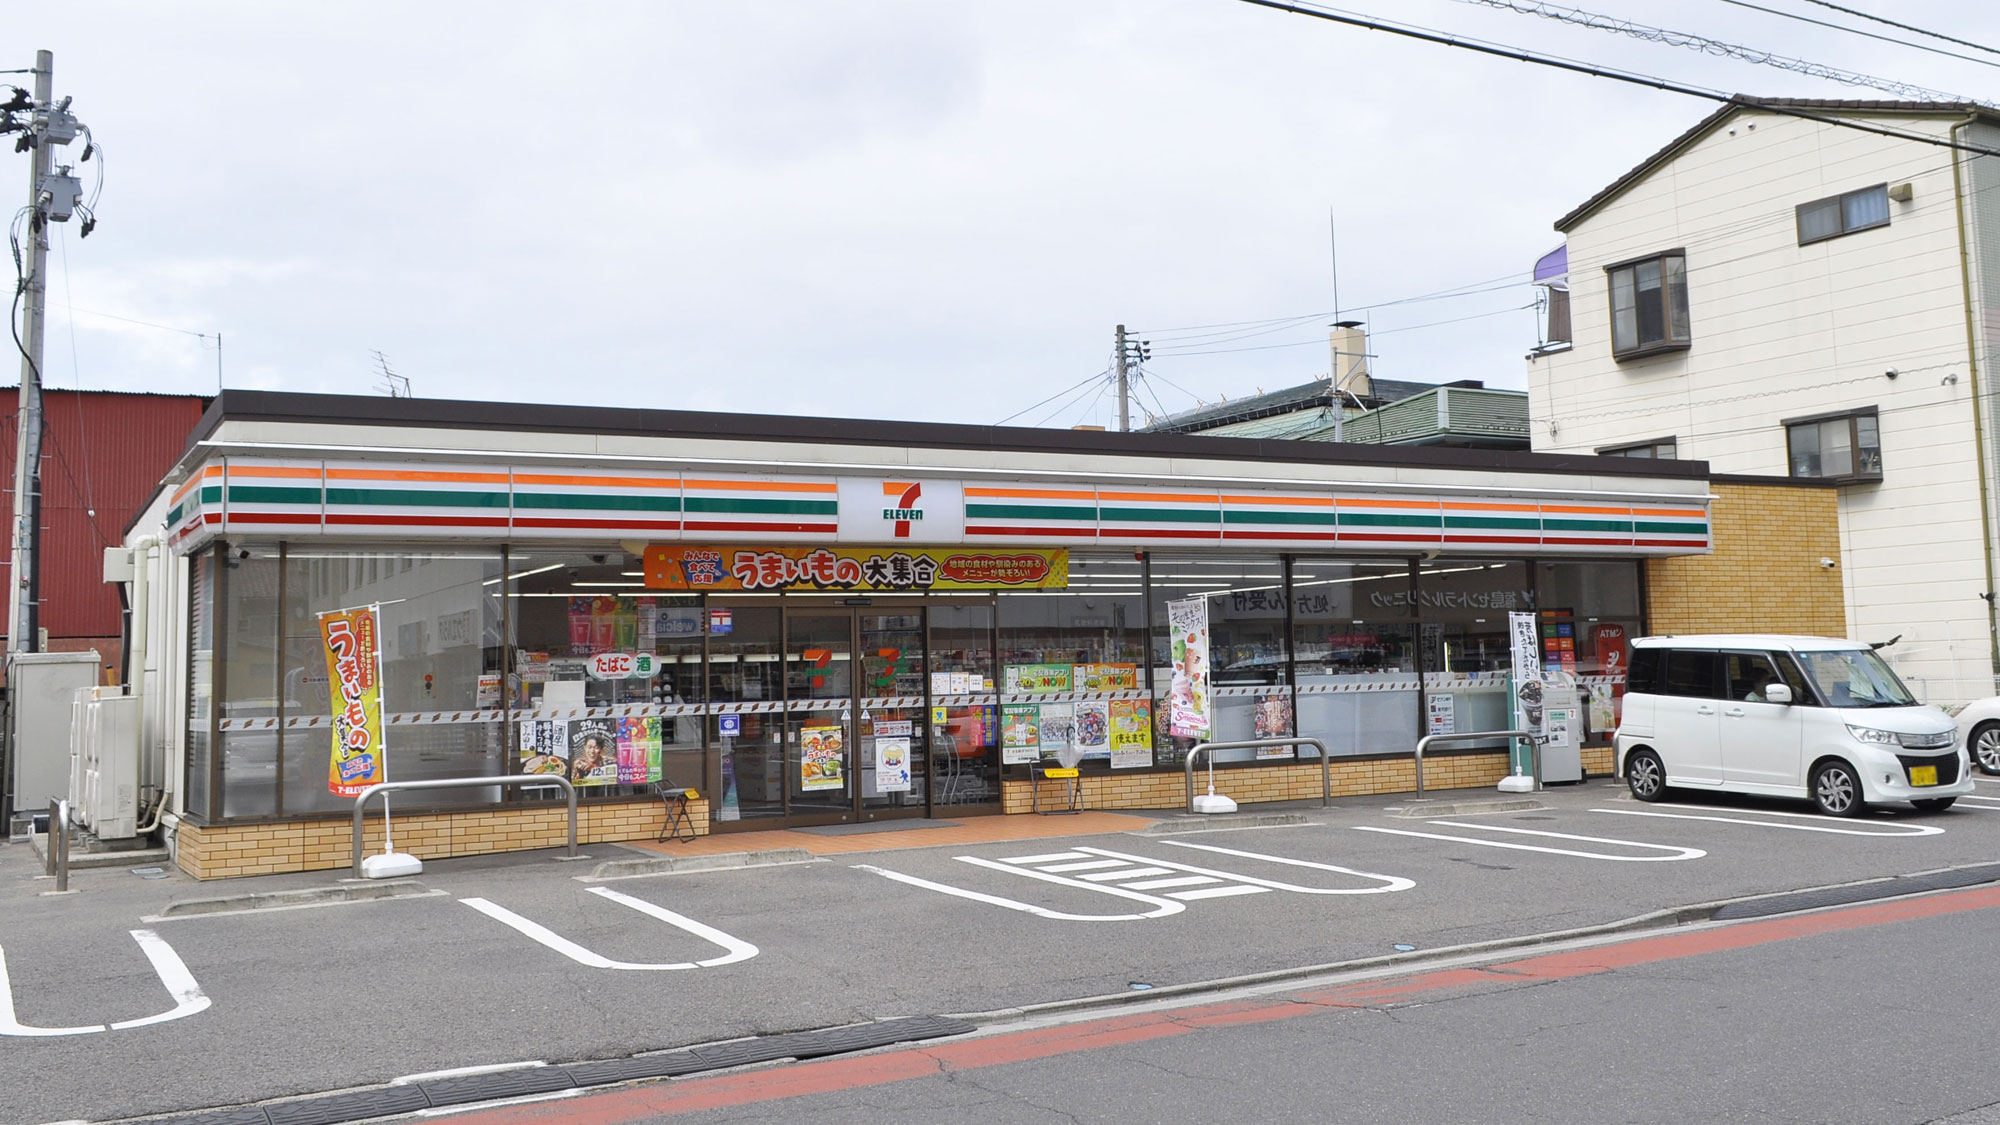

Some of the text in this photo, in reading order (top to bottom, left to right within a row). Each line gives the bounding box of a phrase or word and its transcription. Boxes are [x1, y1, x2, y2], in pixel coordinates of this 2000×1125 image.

[882, 481, 921, 538] 7
[684, 552, 720, 561] みんなで
[688, 562, 716, 571] 食べて
[735, 551, 861, 587] うまいもの
[864, 552, 937, 583] 大集合
[949, 559, 1041, 568] 地域の食材や馴染みのある
[692, 572, 713, 584] 応援
[1600, 630, 1617, 639] ATM
[596, 657, 631, 673] たばこ
[636, 657, 651, 672] 酒
[328, 622, 371, 751] うまいもの
[1115, 733, 1146, 744] 使えます
